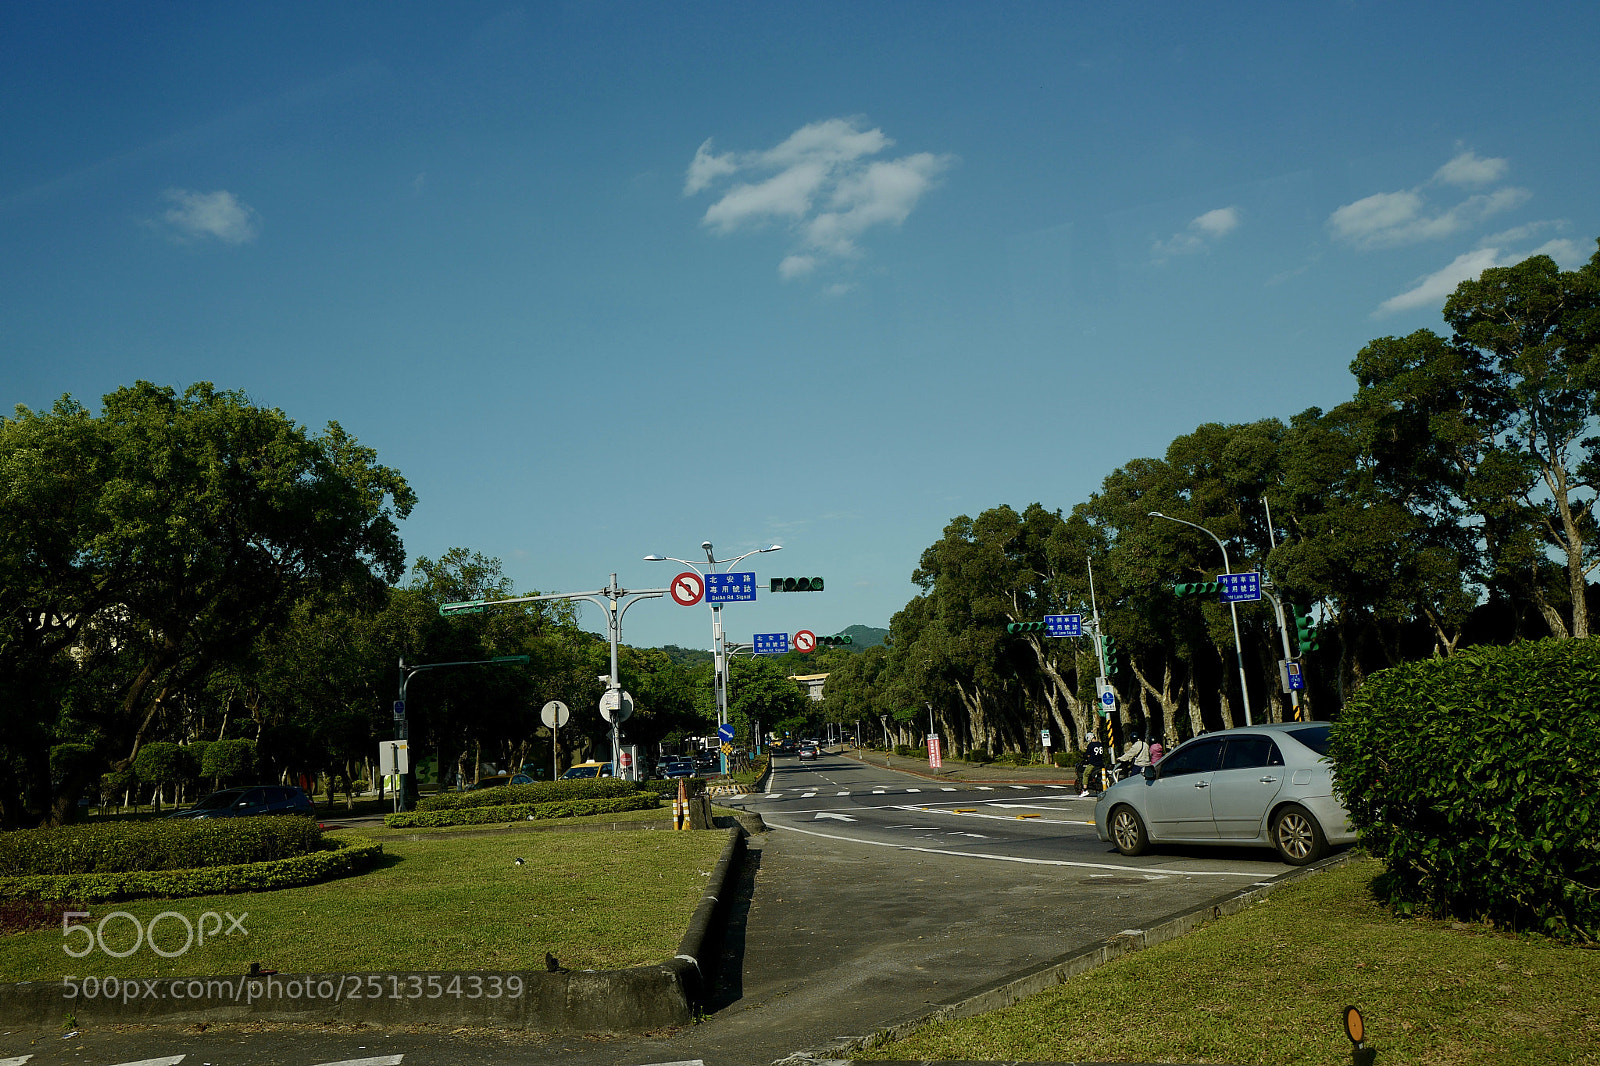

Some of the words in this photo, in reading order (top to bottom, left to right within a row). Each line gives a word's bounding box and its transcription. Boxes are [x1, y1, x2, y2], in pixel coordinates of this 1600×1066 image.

[709, 575, 751, 584] 北安路
[709, 585, 752, 594] 專用號誌
[1093, 746, 1104, 756] 98
